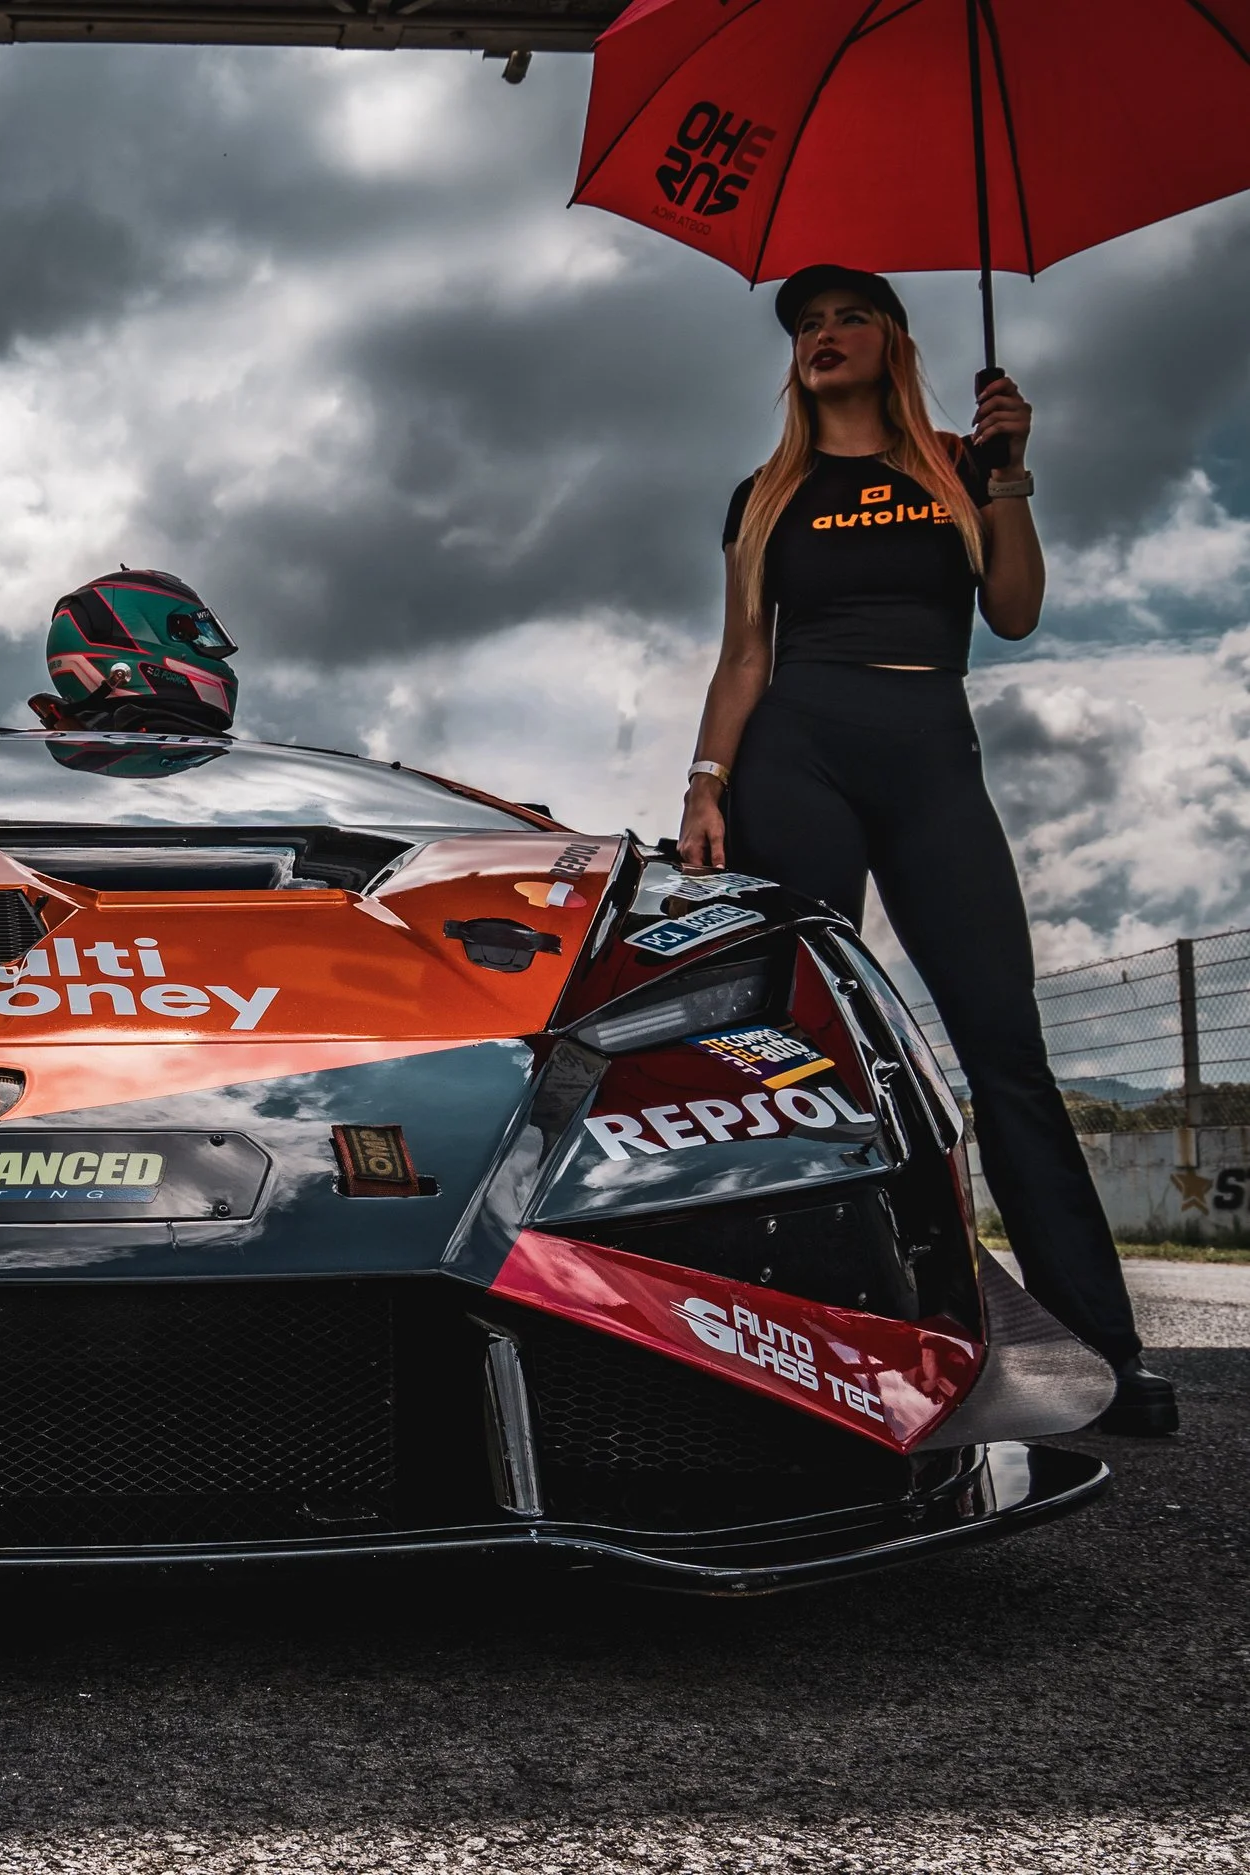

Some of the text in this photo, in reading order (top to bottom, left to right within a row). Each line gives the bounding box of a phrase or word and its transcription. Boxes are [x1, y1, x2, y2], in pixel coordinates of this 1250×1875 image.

[549, 843, 601, 881] REPSOL
[641, 905, 747, 948] PCA LOGISTICS
[699, 1029, 784, 1052] TE COMPRO
[731, 1038, 810, 1063] EL auto
[583, 1086, 876, 1161] REPSOL
[359, 1130, 394, 1176] OMP
[1213, 1168, 1250, 1212] S
[733, 1304, 814, 1363] AUTO
[670, 1297, 885, 1423] GLASS TEC
